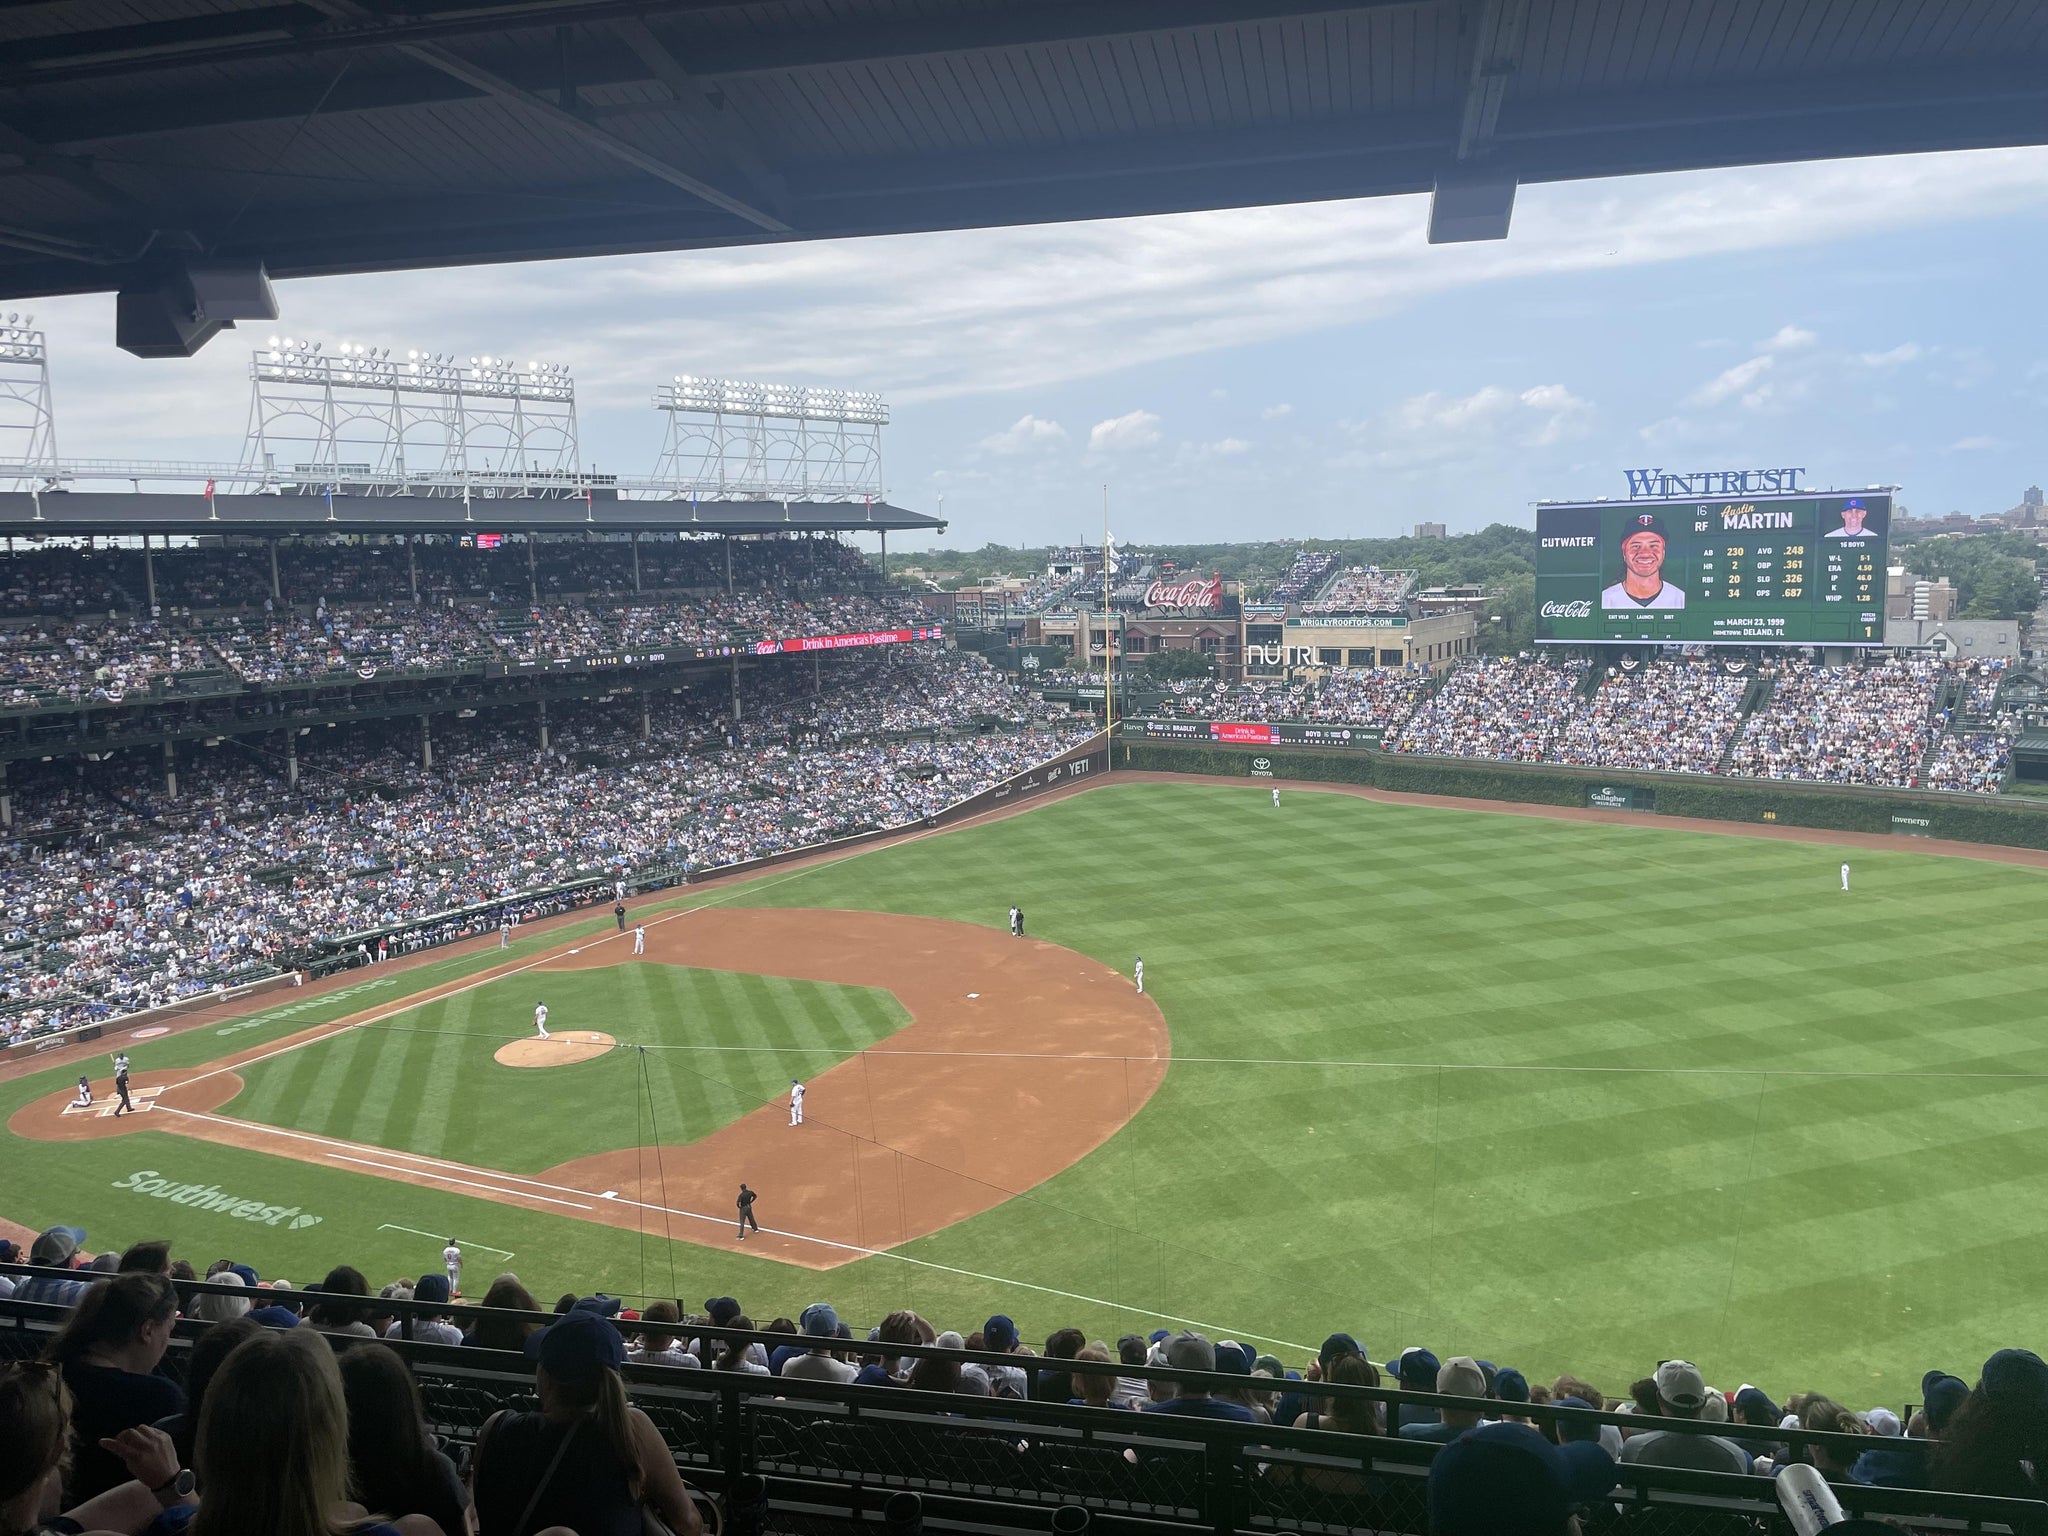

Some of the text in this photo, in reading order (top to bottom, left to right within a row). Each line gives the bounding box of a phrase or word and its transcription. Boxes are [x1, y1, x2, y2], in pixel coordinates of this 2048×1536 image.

[1624, 468, 1805, 497] WINTRUST
[1697, 506, 1707, 516] 16
[1721, 504, 1755, 518] Austin
[1724, 512, 1792, 529] MARTIN
[1695, 522, 1708, 531] RF
[1542, 536, 1594, 548] CUTWATER
[1727, 548, 1744, 556] 230
[1784, 546, 1804, 555] .248
[1784, 560, 1802, 569] .361
[1729, 575, 1740, 584] 20
[1782, 574, 1802, 583] .326
[1144, 579, 1217, 609] Coca-Cola
[1728, 589, 1740, 597] 34
[1782, 588, 1802, 597] .687
[1541, 600, 1593, 618] Coca-Cola
[1754, 619, 1765, 627] 23,
[1743, 629, 1774, 637] DELAND,
[1865, 626, 1871, 637] 1
[802, 633, 898, 650] Drink in America's Pastime
[1069, 758, 1089, 776] YETI
[1591, 794, 1626, 802] Gallagher
[1892, 815, 1930, 827] Invenergy
[35, 1038, 65, 1050] MARQUEE
[112, 1170, 301, 1226] Southwest
